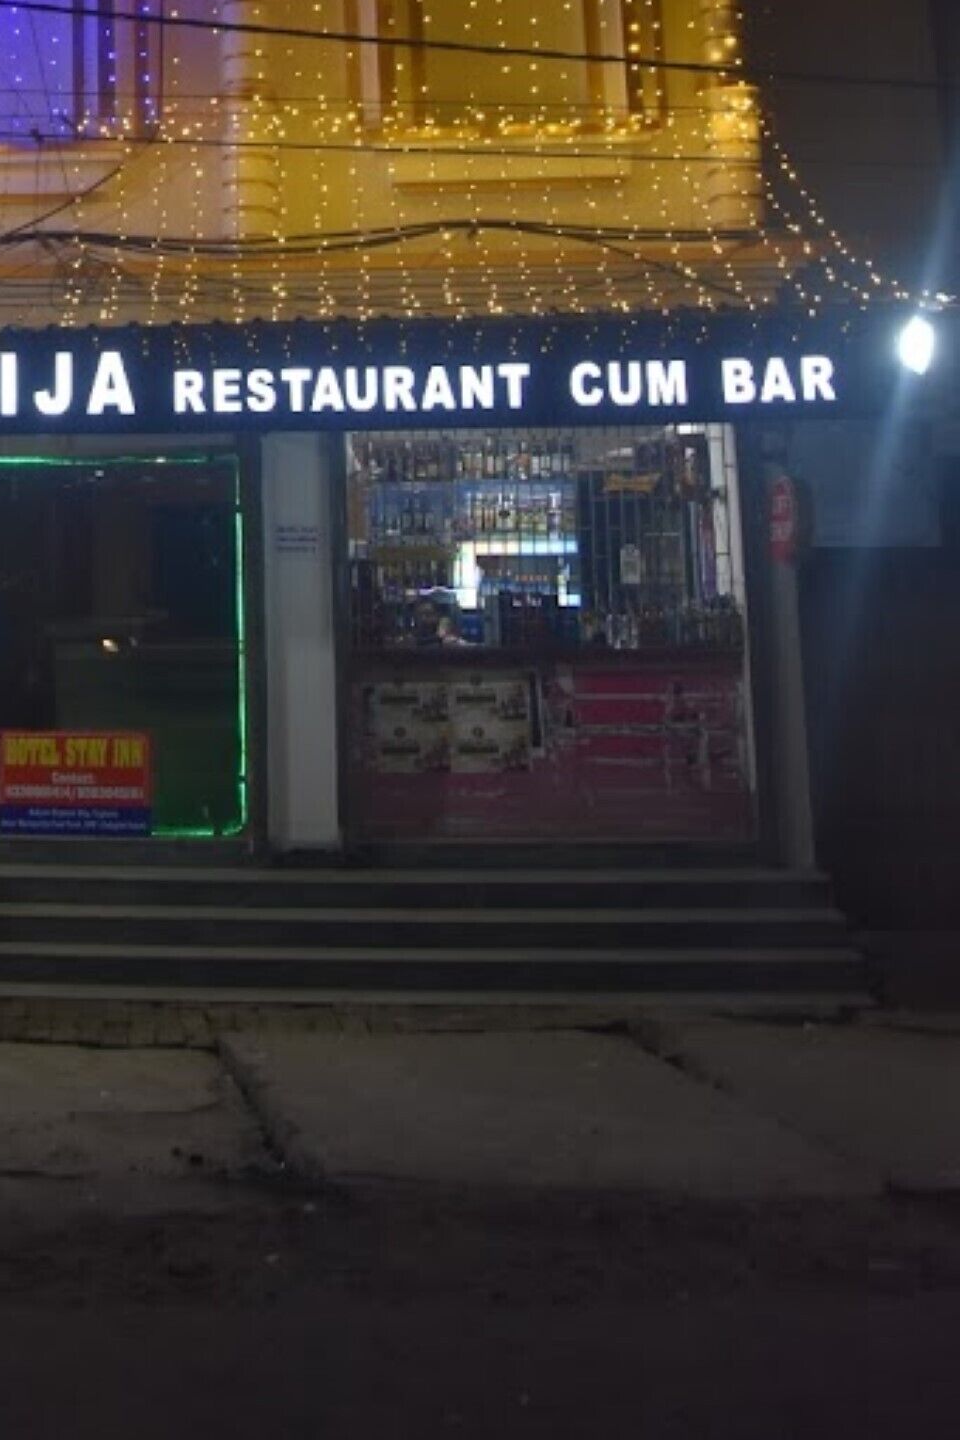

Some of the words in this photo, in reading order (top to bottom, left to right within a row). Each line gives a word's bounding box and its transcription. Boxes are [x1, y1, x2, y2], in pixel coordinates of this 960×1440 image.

[172, 362, 531, 414] RESTAURANT
[569, 359, 688, 407] CUM
[721, 354, 837, 404] BAR
